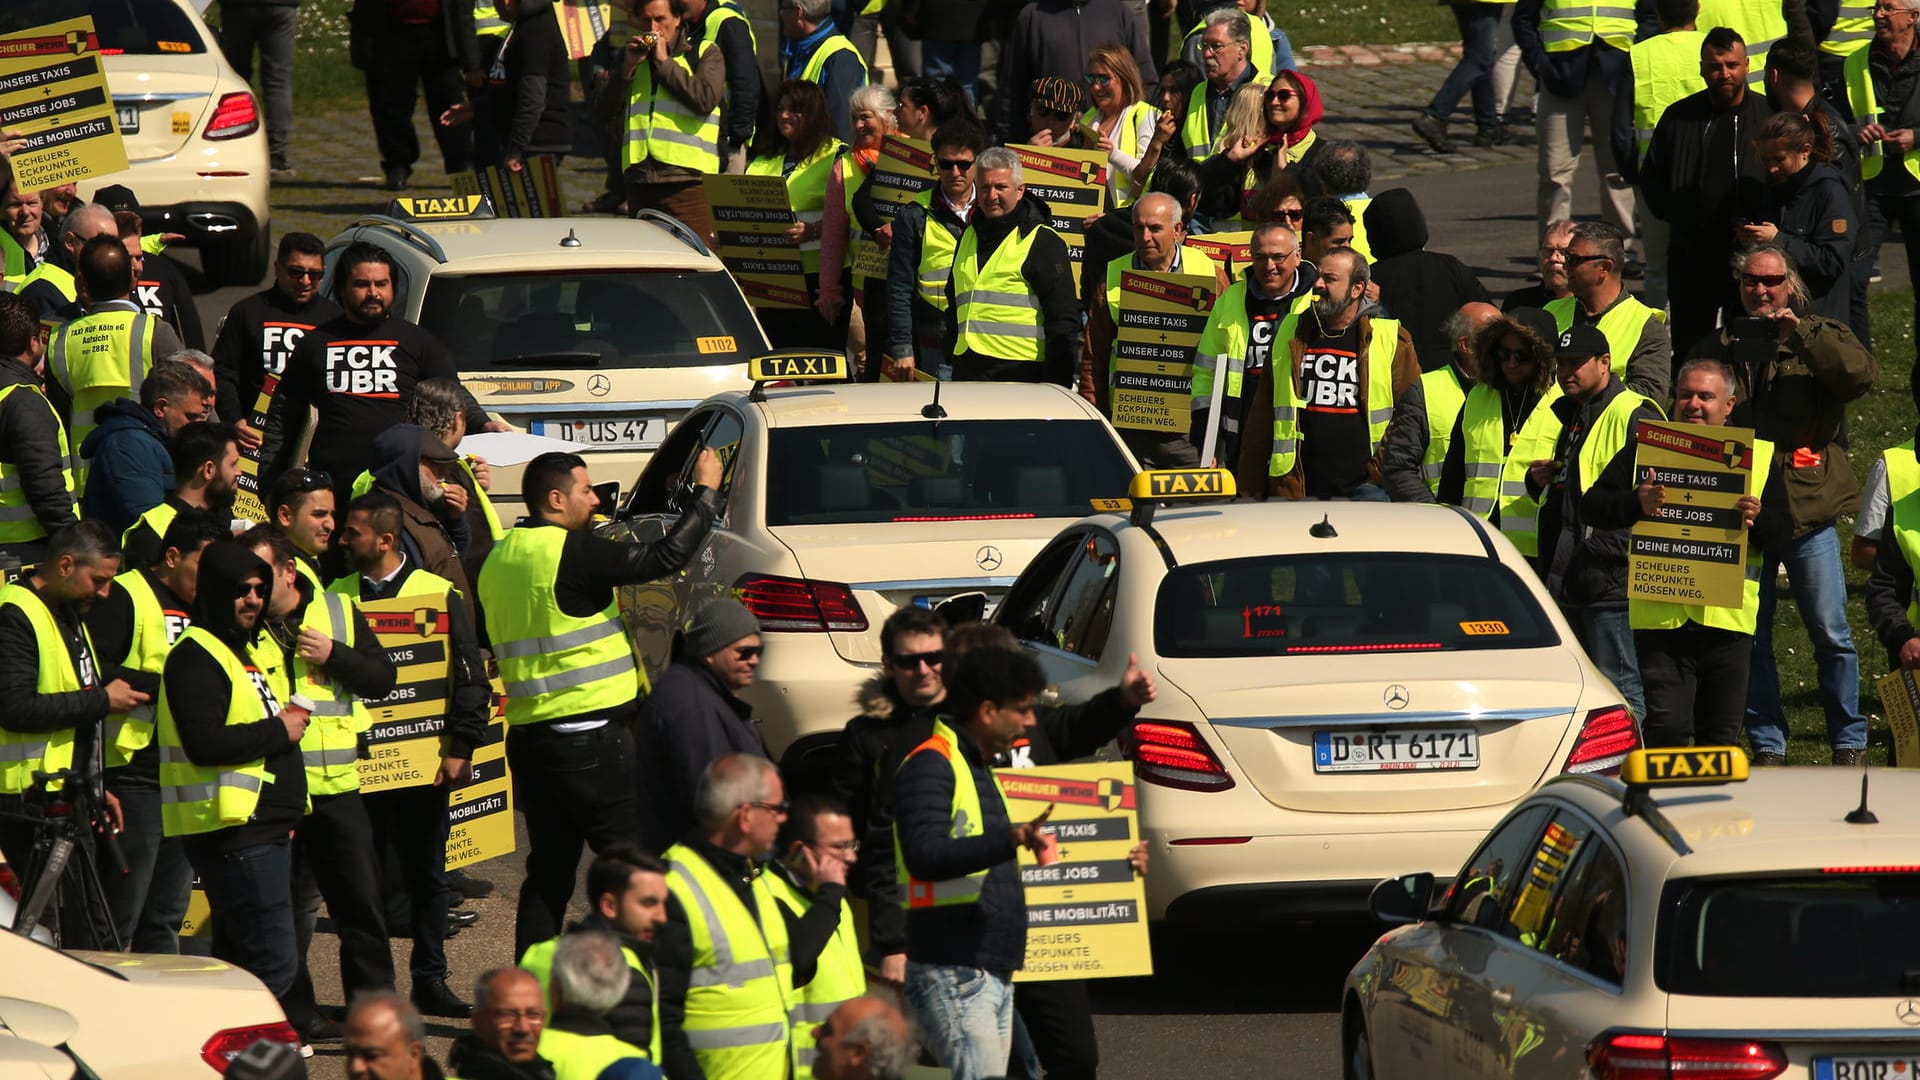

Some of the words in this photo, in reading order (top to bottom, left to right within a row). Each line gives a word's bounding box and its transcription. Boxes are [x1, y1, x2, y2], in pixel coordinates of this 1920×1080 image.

[0, 72, 39, 90] UNSERE
[40, 66, 71, 82] TAXIS
[4, 104, 47, 122] UNSERE
[48, 97, 77, 112] JOBS
[21, 133, 45, 150] INE
[46, 121, 106, 144] MOBILITÄT!
[16, 149, 70, 168] SCHEUERS
[19, 157, 79, 179] ECKPUNKTE
[22, 170, 64, 188] MÜSSEN
[64, 166, 92, 180] WEG.
[876, 173, 901, 186] UNSERE
[902, 177, 922, 189] TAXIS
[1047, 189, 1075, 200] TAXIS
[415, 198, 464, 213] TAXI
[1052, 219, 1070, 229] OBS
[1123, 313, 1160, 326] UNSERE
[1161, 317, 1188, 328] TAXIS
[263, 327, 304, 351] FC
[705, 339, 733, 351] 1102
[1560, 333, 1571, 347] S
[326, 346, 398, 370] FCK
[1121, 345, 1158, 358] UNSERE
[1160, 349, 1184, 359] JOBS
[770, 358, 828, 375] TAXI
[1300, 354, 1359, 383] FCK
[326, 370, 399, 394] UBR
[544, 380, 561, 390] APP
[1119, 375, 1148, 387] DEINE
[1149, 377, 1192, 390] MOBILITÄ
[1119, 393, 1165, 405] SCHEUERS
[1117, 405, 1170, 416] ECKPUNKTE
[1116, 414, 1153, 425] MÜSSEN
[1154, 418, 1177, 427] WEG.
[560, 421, 573, 441] D
[590, 420, 618, 442] US
[623, 420, 649, 441] 47
[236, 475, 258, 490] EIN
[1153, 474, 1220, 494] TAXI
[1687, 474, 1718, 487] TAXIS
[1103, 500, 1121, 509] 53
[1651, 507, 1683, 520] SERE
[1684, 510, 1713, 523] JOBS
[1636, 540, 1669, 553] DEINE
[1672, 543, 1733, 559] MOBILITÄT!
[1636, 561, 1690, 574] SCHEUERS
[1634, 572, 1696, 587] ECKPUNKTE
[1634, 583, 1676, 597] MÜSSEN
[1677, 588, 1705, 600] WEG.
[1254, 606, 1281, 617] 171
[1467, 623, 1504, 634] 1330
[387, 650, 414, 663] XIS
[1333, 736, 1349, 761] D
[1368, 734, 1402, 760] RT
[1409, 733, 1474, 759] 6171
[357, 759, 409, 774] KPUNKTE
[1649, 753, 1729, 777] TAXI
[360, 773, 391, 787] SSEN
[392, 769, 423, 782] WEG.
[449, 797, 501, 821] MOBILITÄT!
[1058, 823, 1098, 837] TAXIS
[458, 847, 482, 862] WEG.
[1021, 866, 1061, 882] SERE
[1063, 865, 1099, 880] JOBS
[1028, 909, 1052, 922] INE
[1054, 903, 1130, 921] MOBILITÄT!
[1026, 933, 1081, 945] CHEUERS
[1024, 946, 1090, 959] CKPUNKTE
[1073, 959, 1103, 971] WEG.
